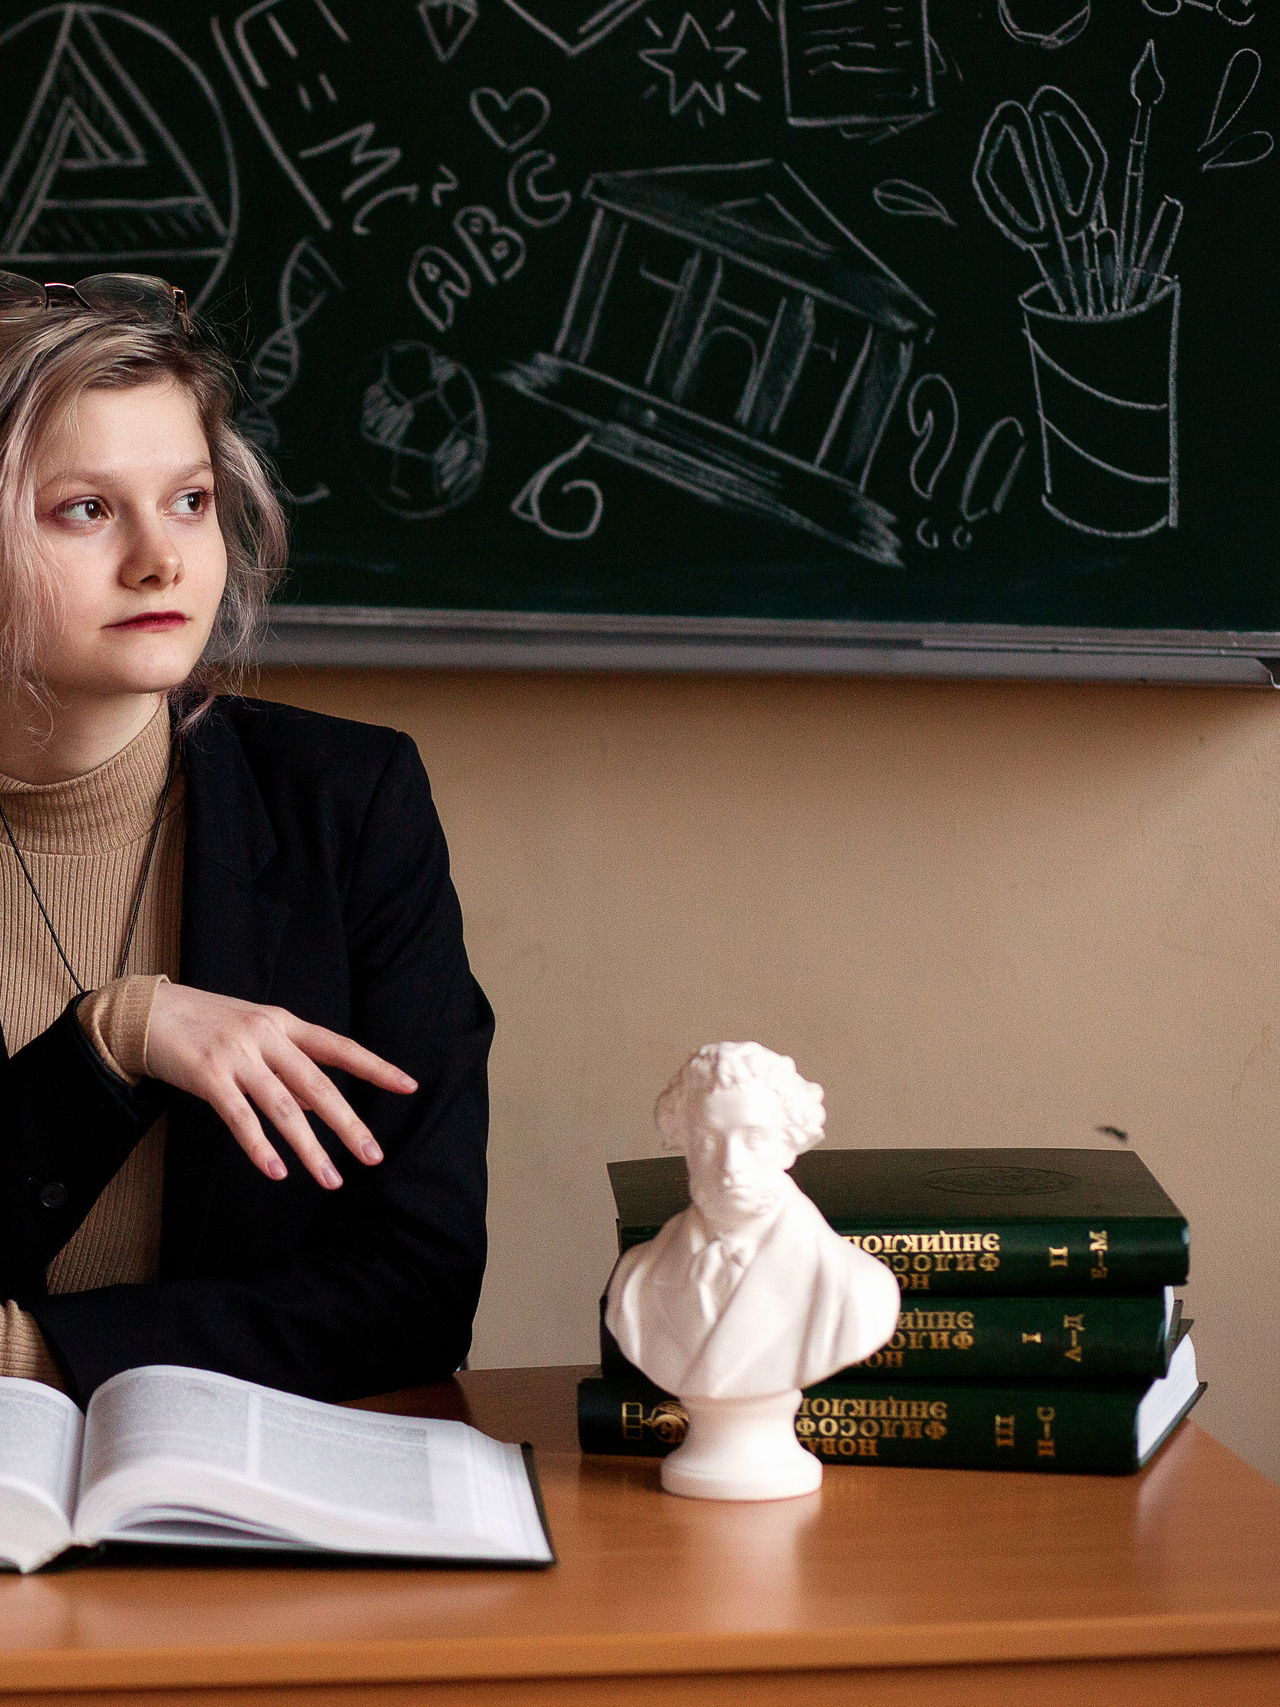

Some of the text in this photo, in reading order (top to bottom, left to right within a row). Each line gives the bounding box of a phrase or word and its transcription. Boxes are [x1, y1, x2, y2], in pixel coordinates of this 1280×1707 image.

[407, 150, 571, 332] ABC
[853, 1350, 904, 1368] НО
[795, 1418, 948, 1440] ФИЛОСОФ
